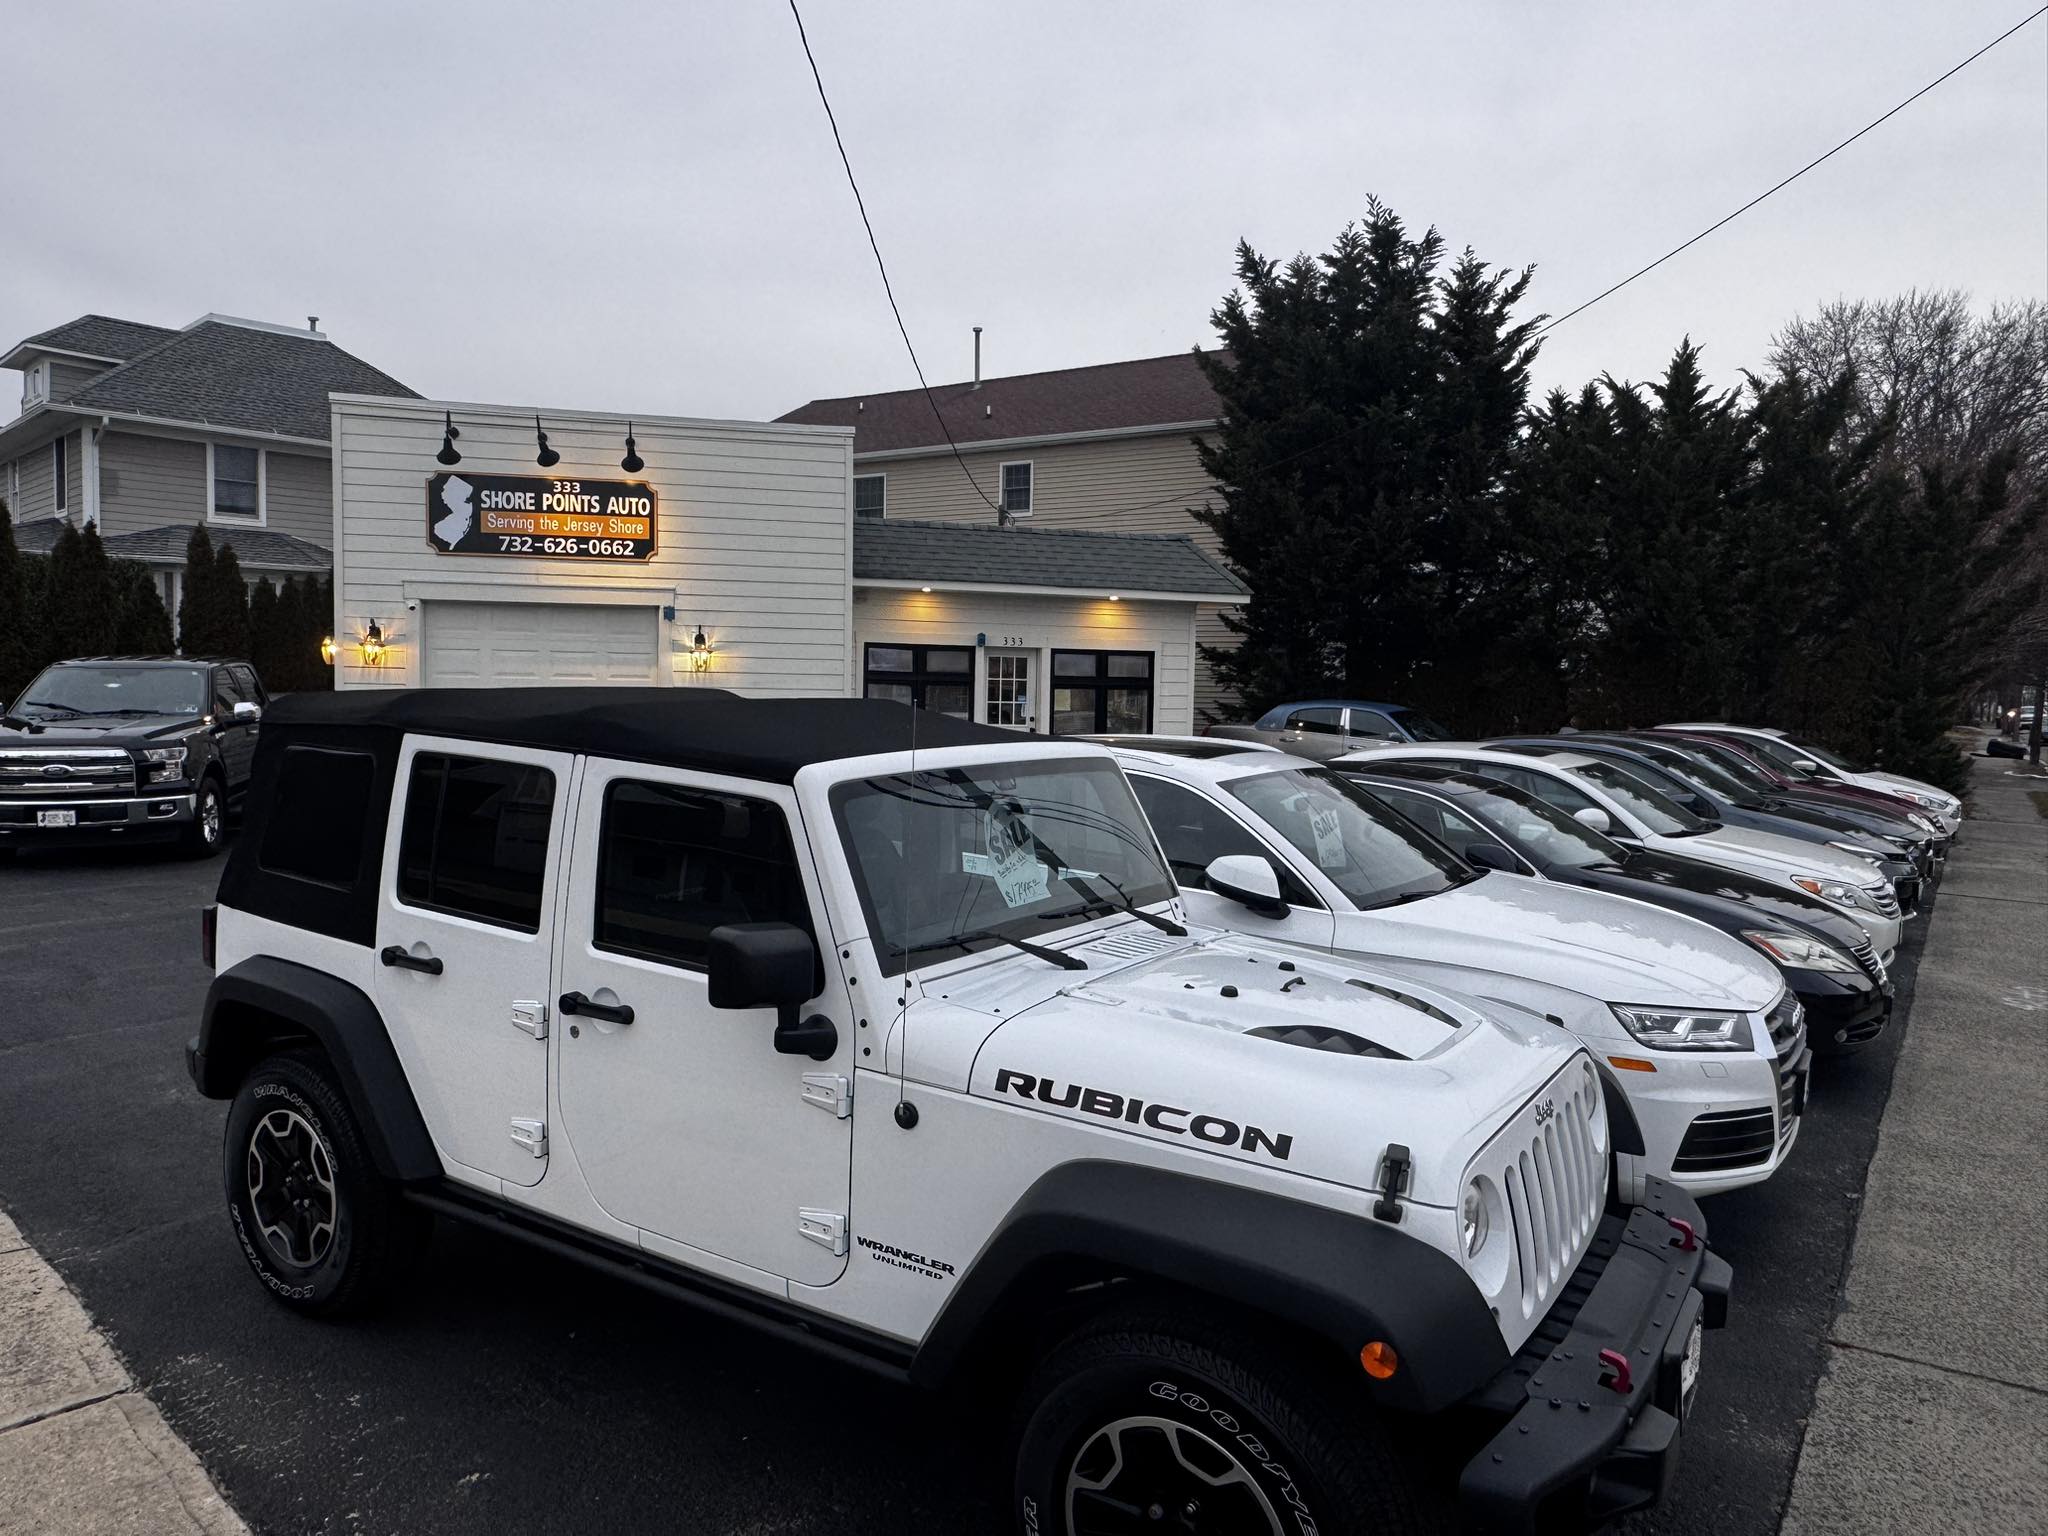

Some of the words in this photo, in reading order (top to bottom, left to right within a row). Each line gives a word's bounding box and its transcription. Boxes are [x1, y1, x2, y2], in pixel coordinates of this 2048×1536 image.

[553, 481, 580, 493] 333
[480, 490, 535, 510] SHORE
[542, 494, 600, 513] POINTS
[606, 496, 650, 516] AUTO
[487, 513, 534, 532] Serving
[539, 516, 559, 531] the
[563, 517, 603, 537] Jersey
[608, 518, 643, 534] Shore
[499, 536, 635, 556] 732-626-0662
[1003, 636, 1023, 647] 333
[994, 1068, 1293, 1161] RUBICON
[857, 1235, 956, 1277] WRANGLER
[872, 1253, 944, 1280] UNLIMITED
